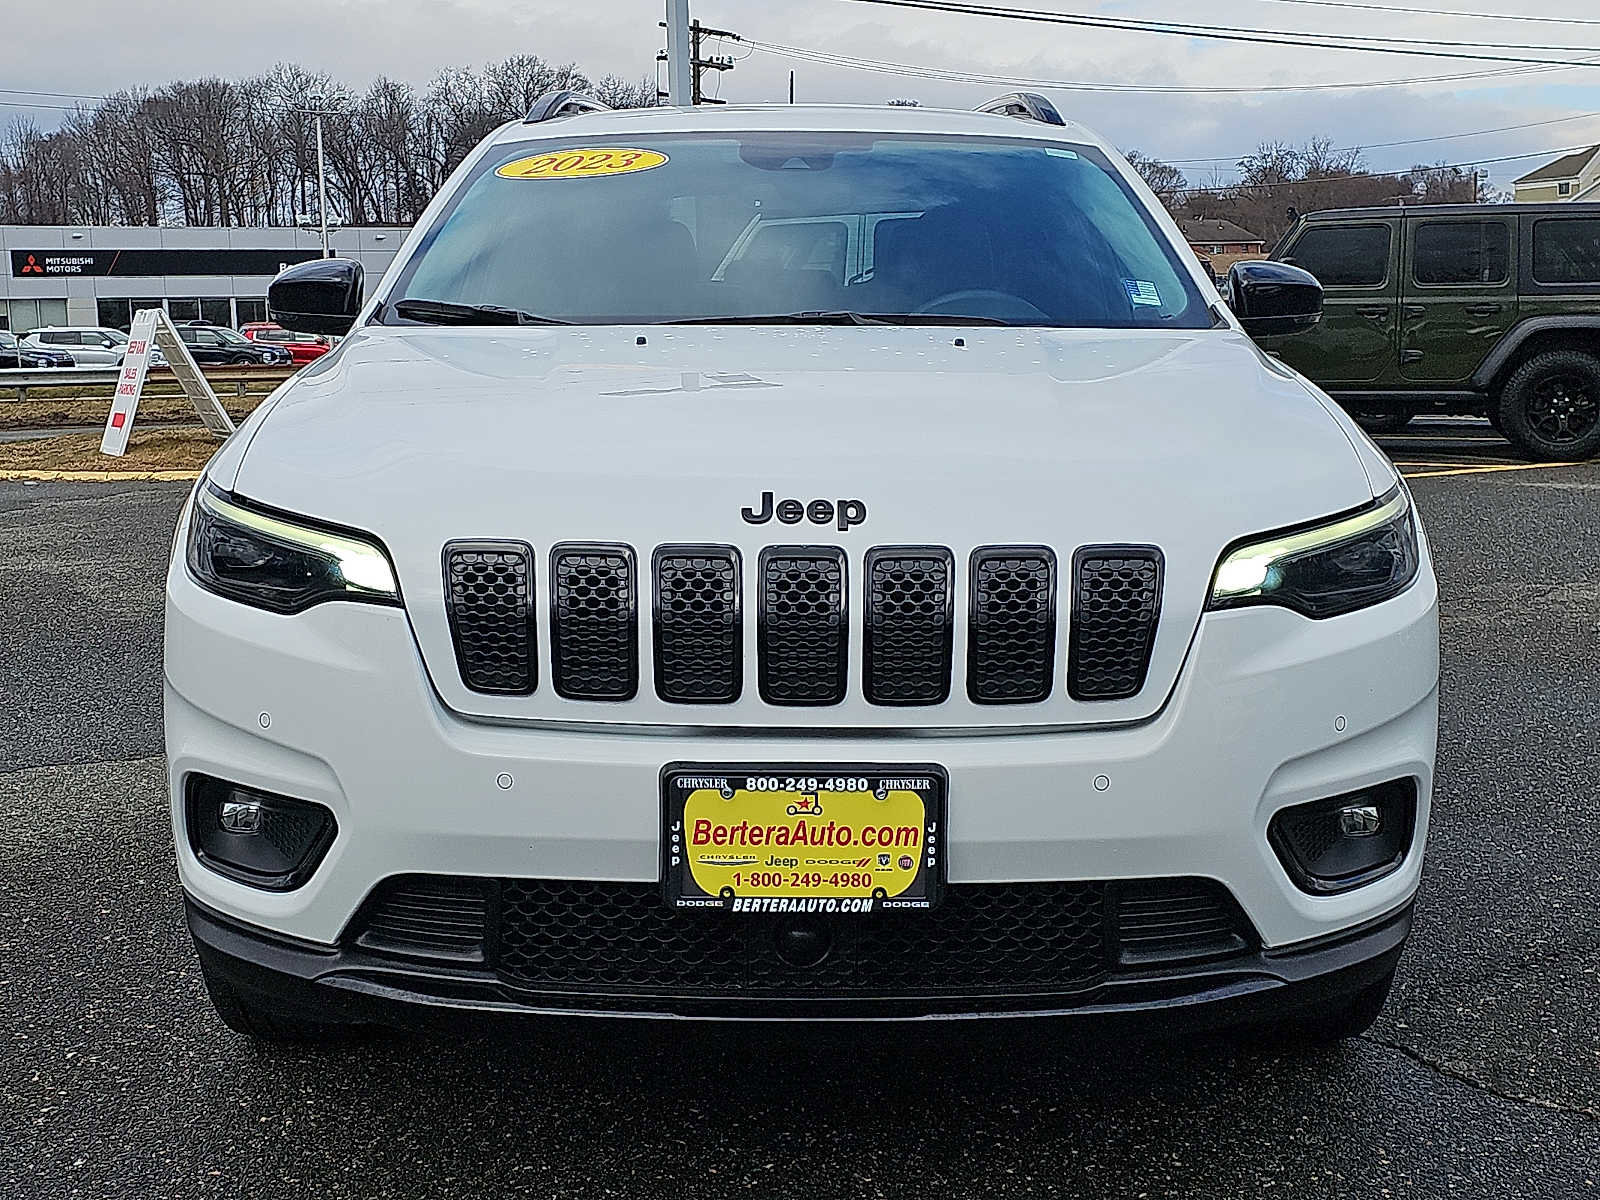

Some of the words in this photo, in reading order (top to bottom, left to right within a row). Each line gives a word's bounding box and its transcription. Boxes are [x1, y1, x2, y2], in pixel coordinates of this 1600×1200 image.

[520, 153, 642, 175] 2023
[45, 257, 94, 265] MITSUBISHI
[46, 265, 82, 273] MOTORS
[741, 491, 867, 532] Jeep
[677, 778, 729, 789] CHRYSLER
[746, 777, 868, 791] 800-249-4980
[879, 779, 931, 790] CHRYSLER
[692, 819, 919, 847] BerteraAuto.com
[671, 820, 681, 867] Jeep
[927, 821, 937, 868] Jeep
[764, 855, 799, 868] Jeep
[733, 872, 872, 888] 1-800-249-4980
[732, 898, 874, 912] BERTERAAUTO.COM
